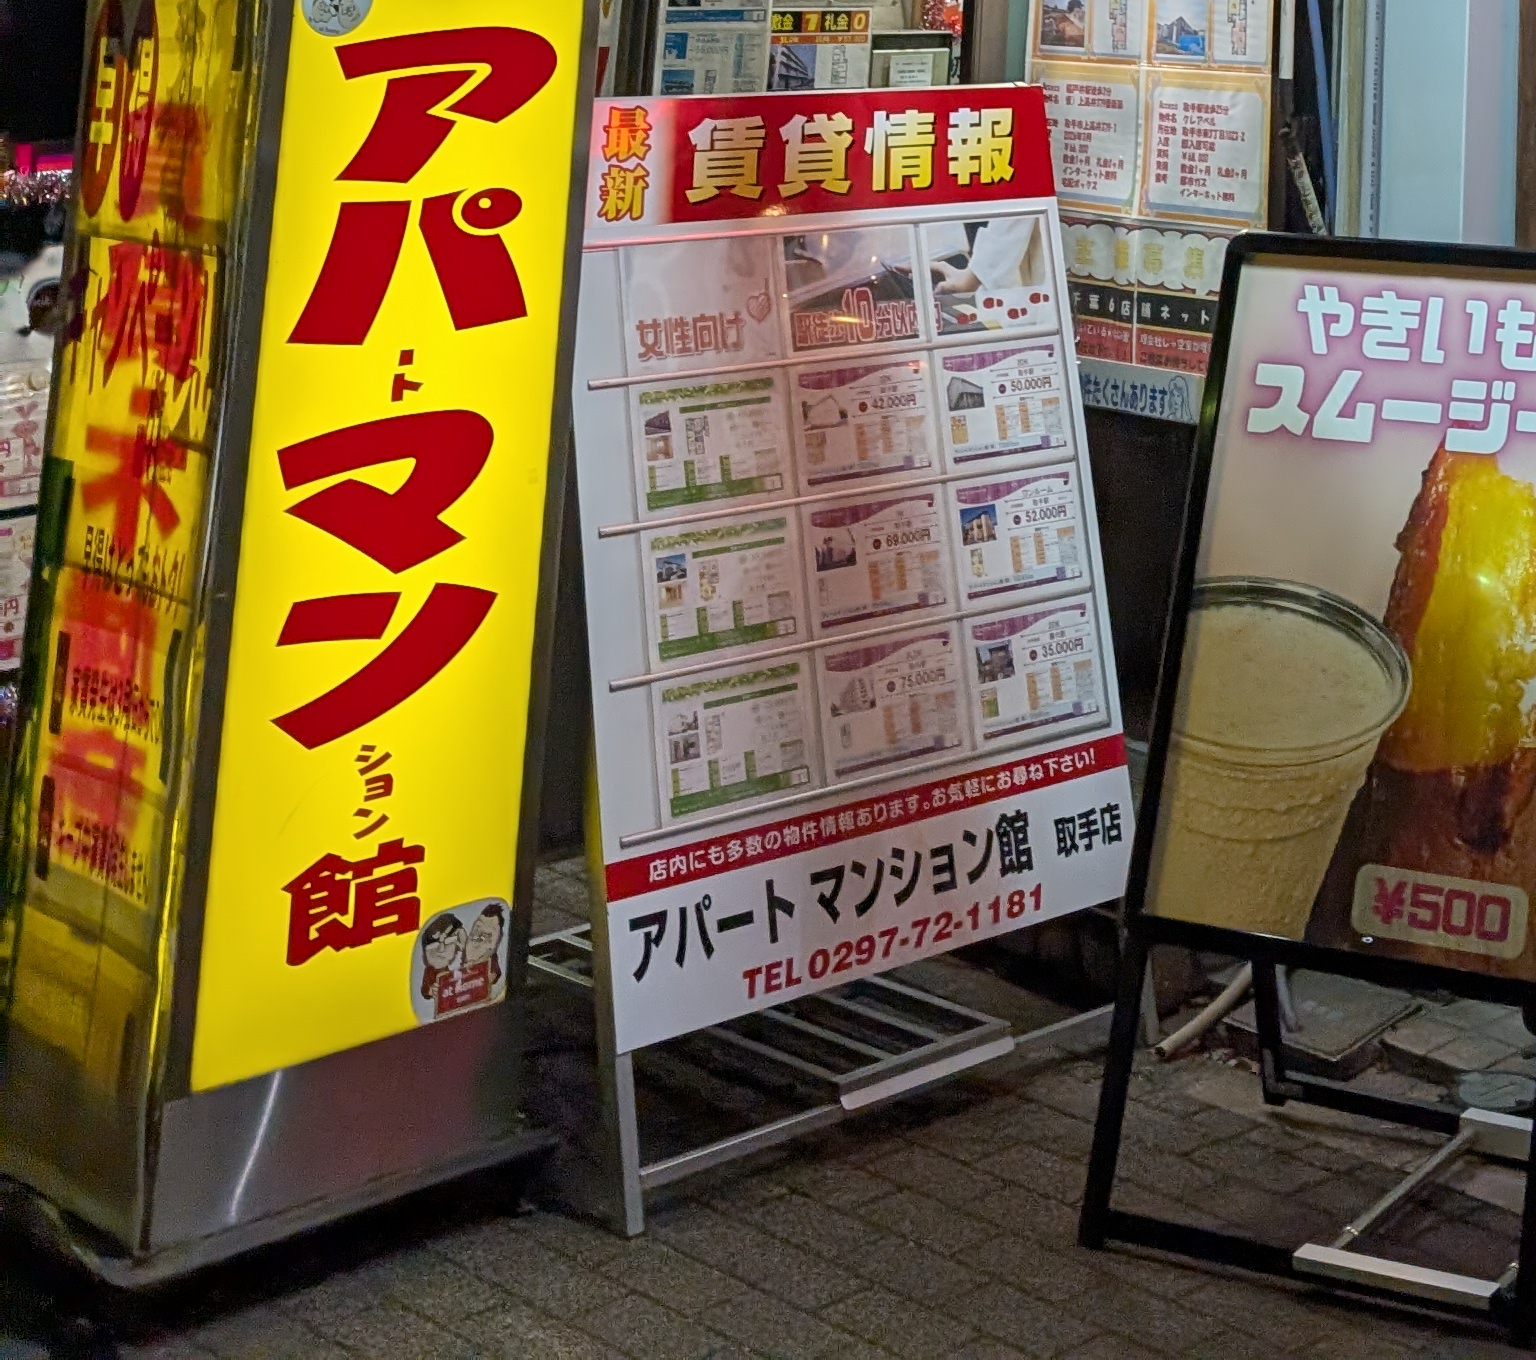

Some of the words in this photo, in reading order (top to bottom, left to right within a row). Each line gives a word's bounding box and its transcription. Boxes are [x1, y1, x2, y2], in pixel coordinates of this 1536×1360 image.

[598, 106, 652, 222] 最新
[686, 107, 1015, 205] 賃貸情報
[636, 310, 748, 361] 女性向け
[1054, 802, 1123, 859] 取手店
[743, 961, 802, 1000] TEL
[807, 883, 1044, 981] 0297-72-1181
[1373, 877, 1511, 944] ¥500
